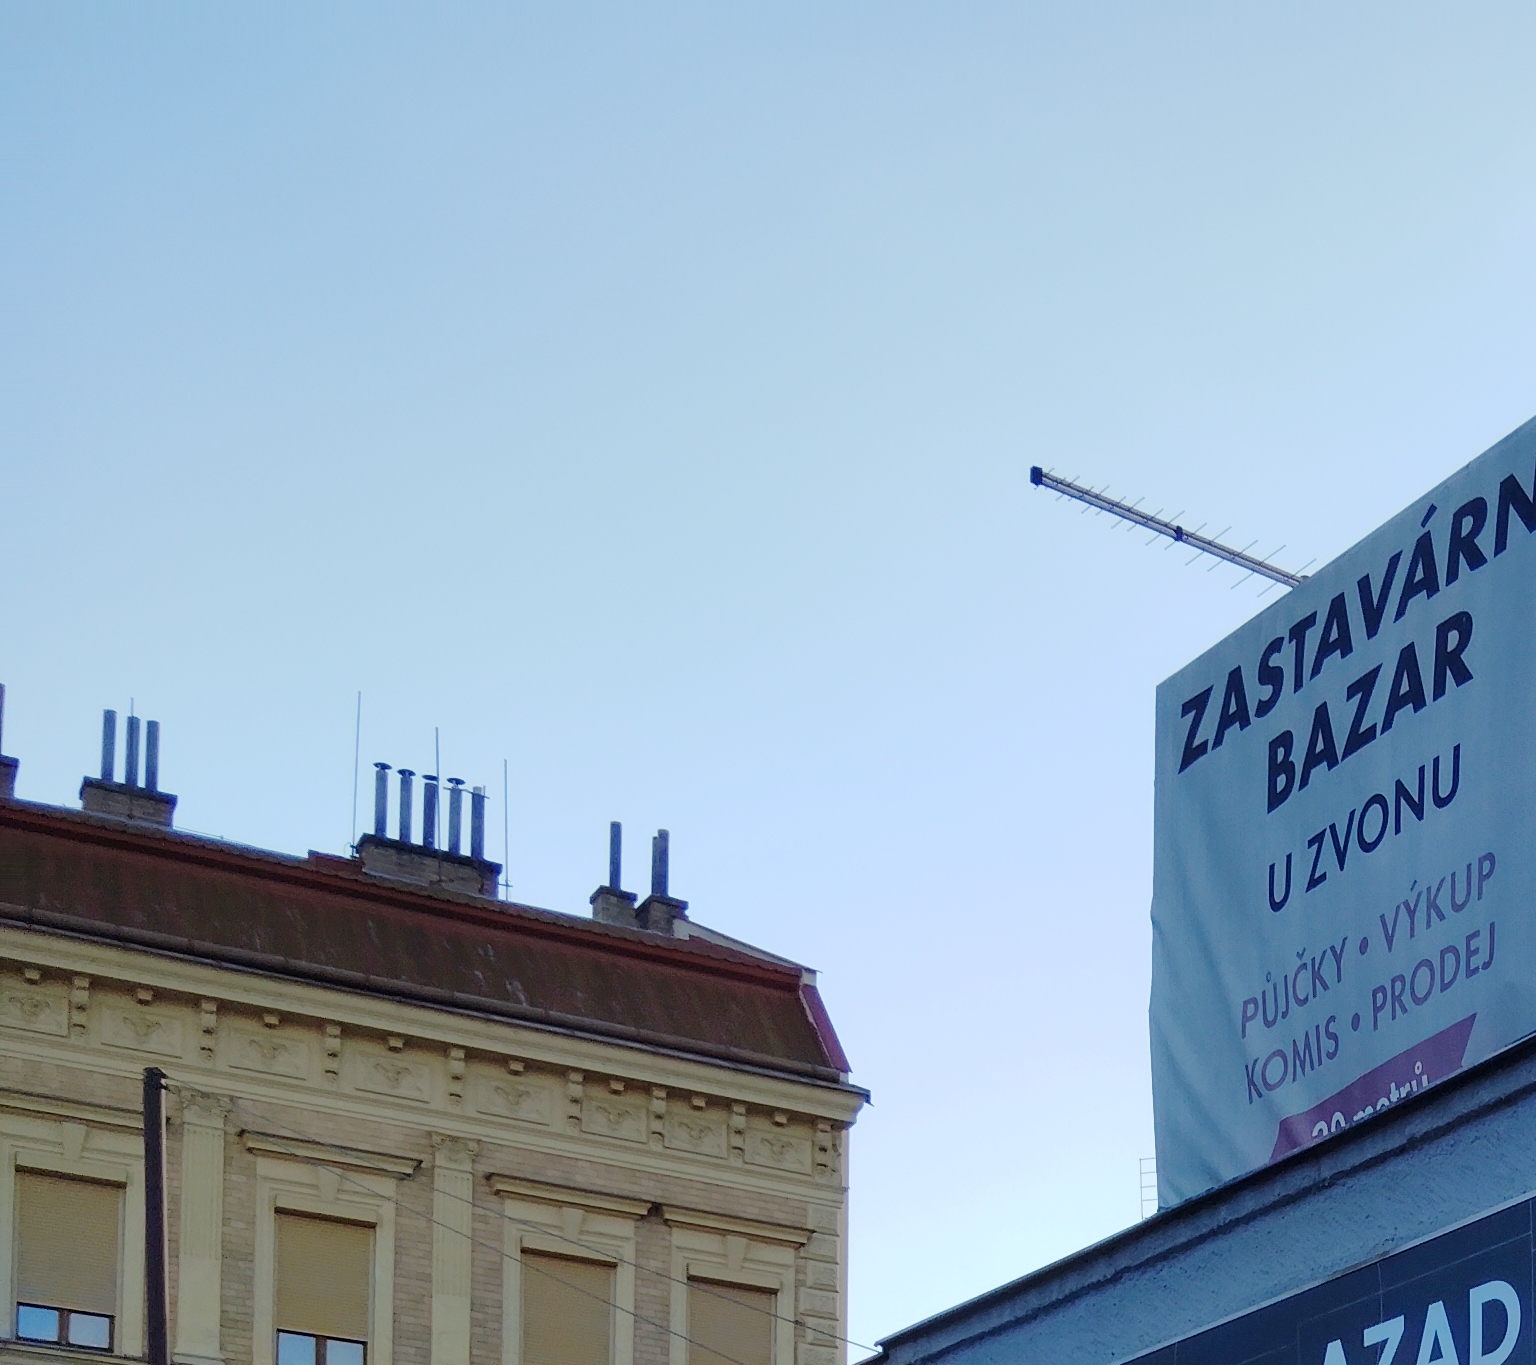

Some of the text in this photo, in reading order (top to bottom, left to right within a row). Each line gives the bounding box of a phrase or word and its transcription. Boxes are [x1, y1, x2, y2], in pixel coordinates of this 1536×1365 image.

[1266, 610, 1475, 813] BAZAR
[1268, 744, 1462, 913] U ZVONU
[1240, 852, 1499, 1038] PŮJČKY VÝKUP
[1244, 922, 1499, 1105] KOMIS PRODEJ
